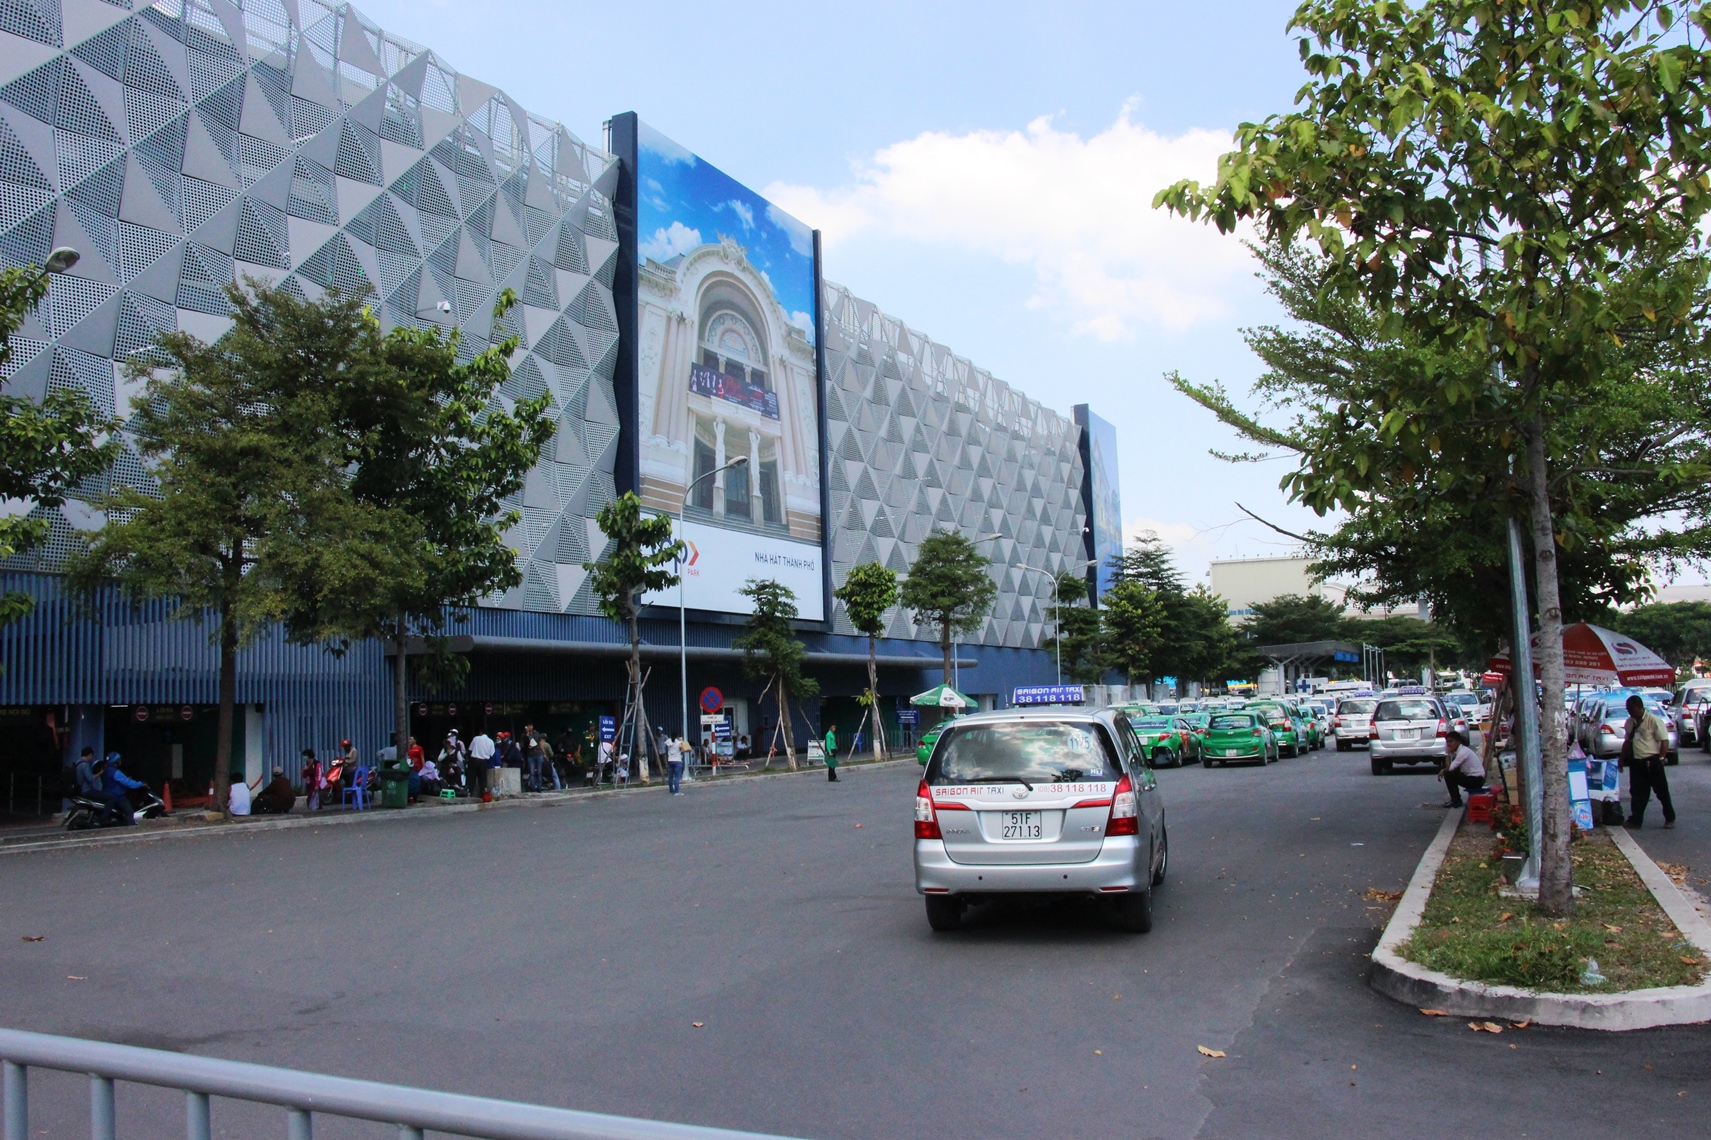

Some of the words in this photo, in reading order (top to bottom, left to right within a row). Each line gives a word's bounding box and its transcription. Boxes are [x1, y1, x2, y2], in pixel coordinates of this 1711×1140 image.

[754, 551, 769, 564] NHÀ
[769, 553, 782, 566] HÁT
[782, 555, 803, 569] THÀNH
[803, 558, 815, 571] PHỐ
[1017, 687, 1050, 695] SAIGON
[1018, 695, 1033, 703] 38
[1035, 694, 1057, 702] 118
[1059, 693, 1081, 701] 118
[935, 787, 969, 797] SAIGON
[986, 786, 1005, 795] TAXI
[1065, 783, 1085, 793] 118
[1087, 783, 1107, 793] 118
[1011, 812, 1032, 825] 51F
[1003, 825, 1040, 838] 271.13
